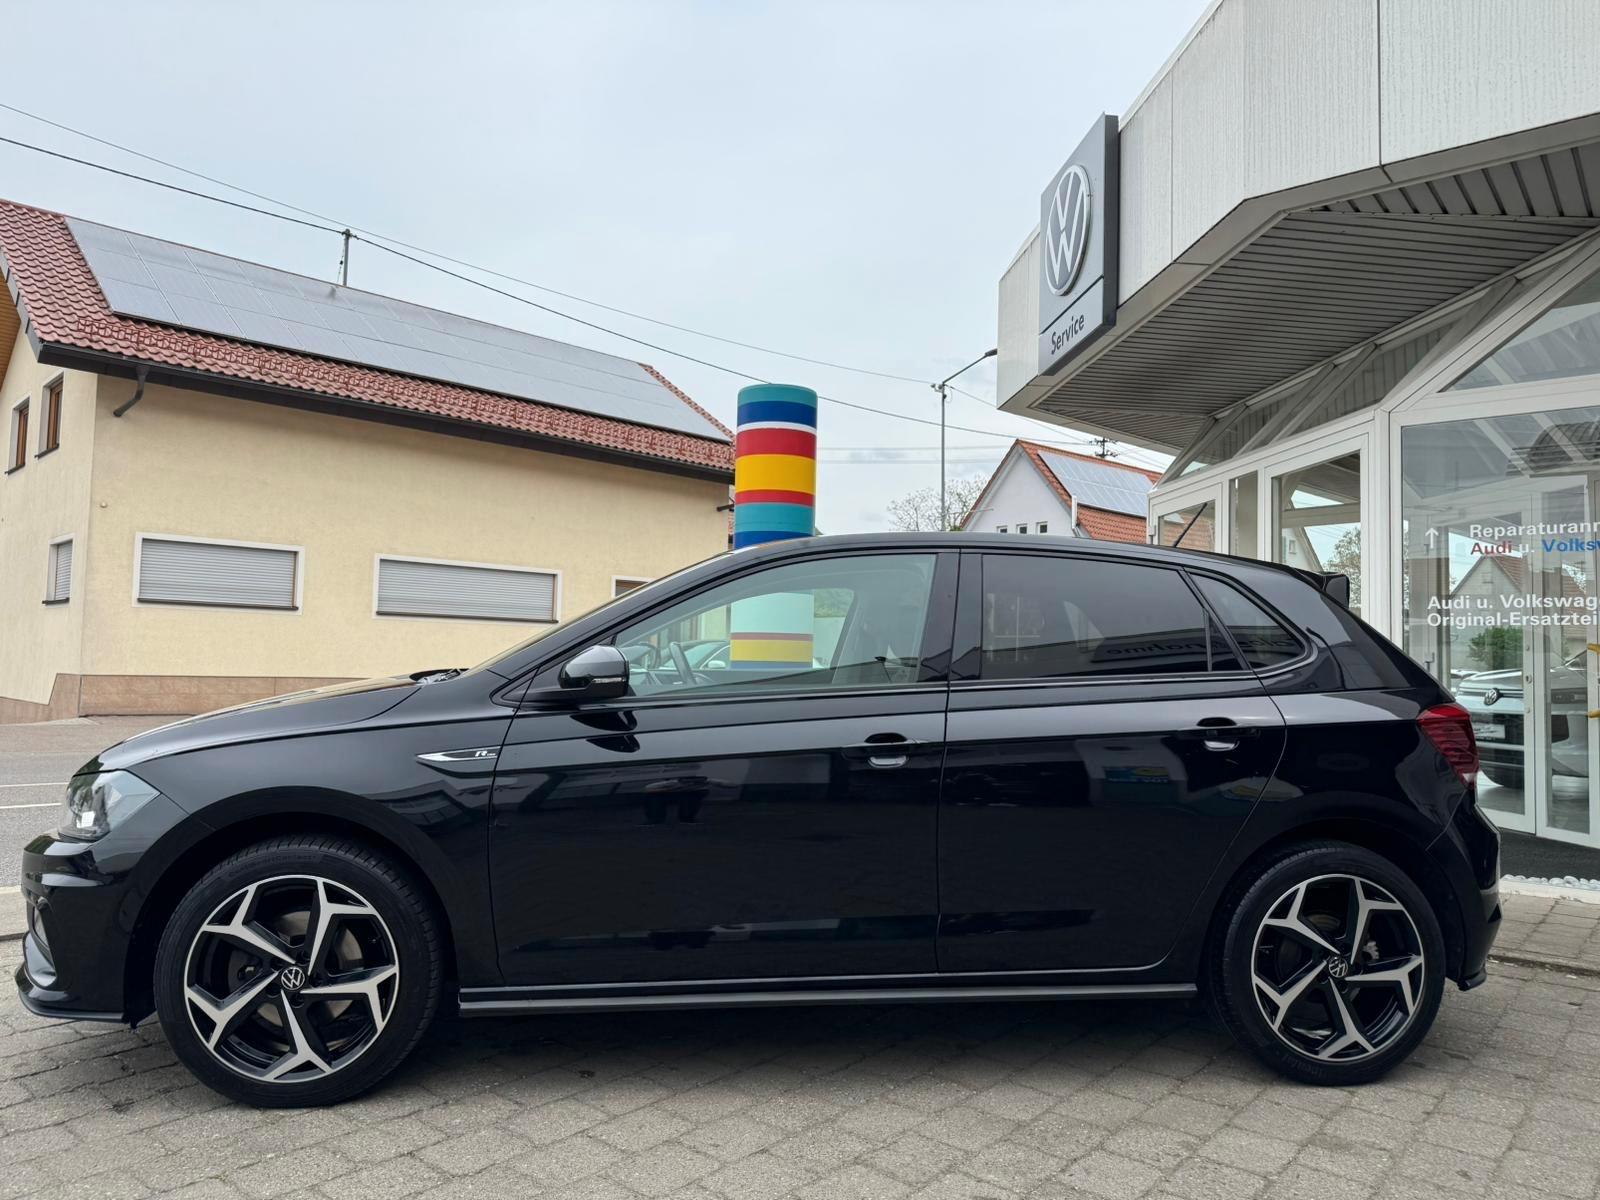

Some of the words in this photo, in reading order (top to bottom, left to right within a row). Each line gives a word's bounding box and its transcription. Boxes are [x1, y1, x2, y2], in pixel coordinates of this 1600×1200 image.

[1051, 312, 1085, 355] Service
[1470, 540, 1512, 555] Audi
[1519, 543, 1535, 553] u.
[1427, 595, 1470, 609] Audi
[1476, 598, 1493, 609] u.
[1500, 593, 1600, 611] Volkswag
